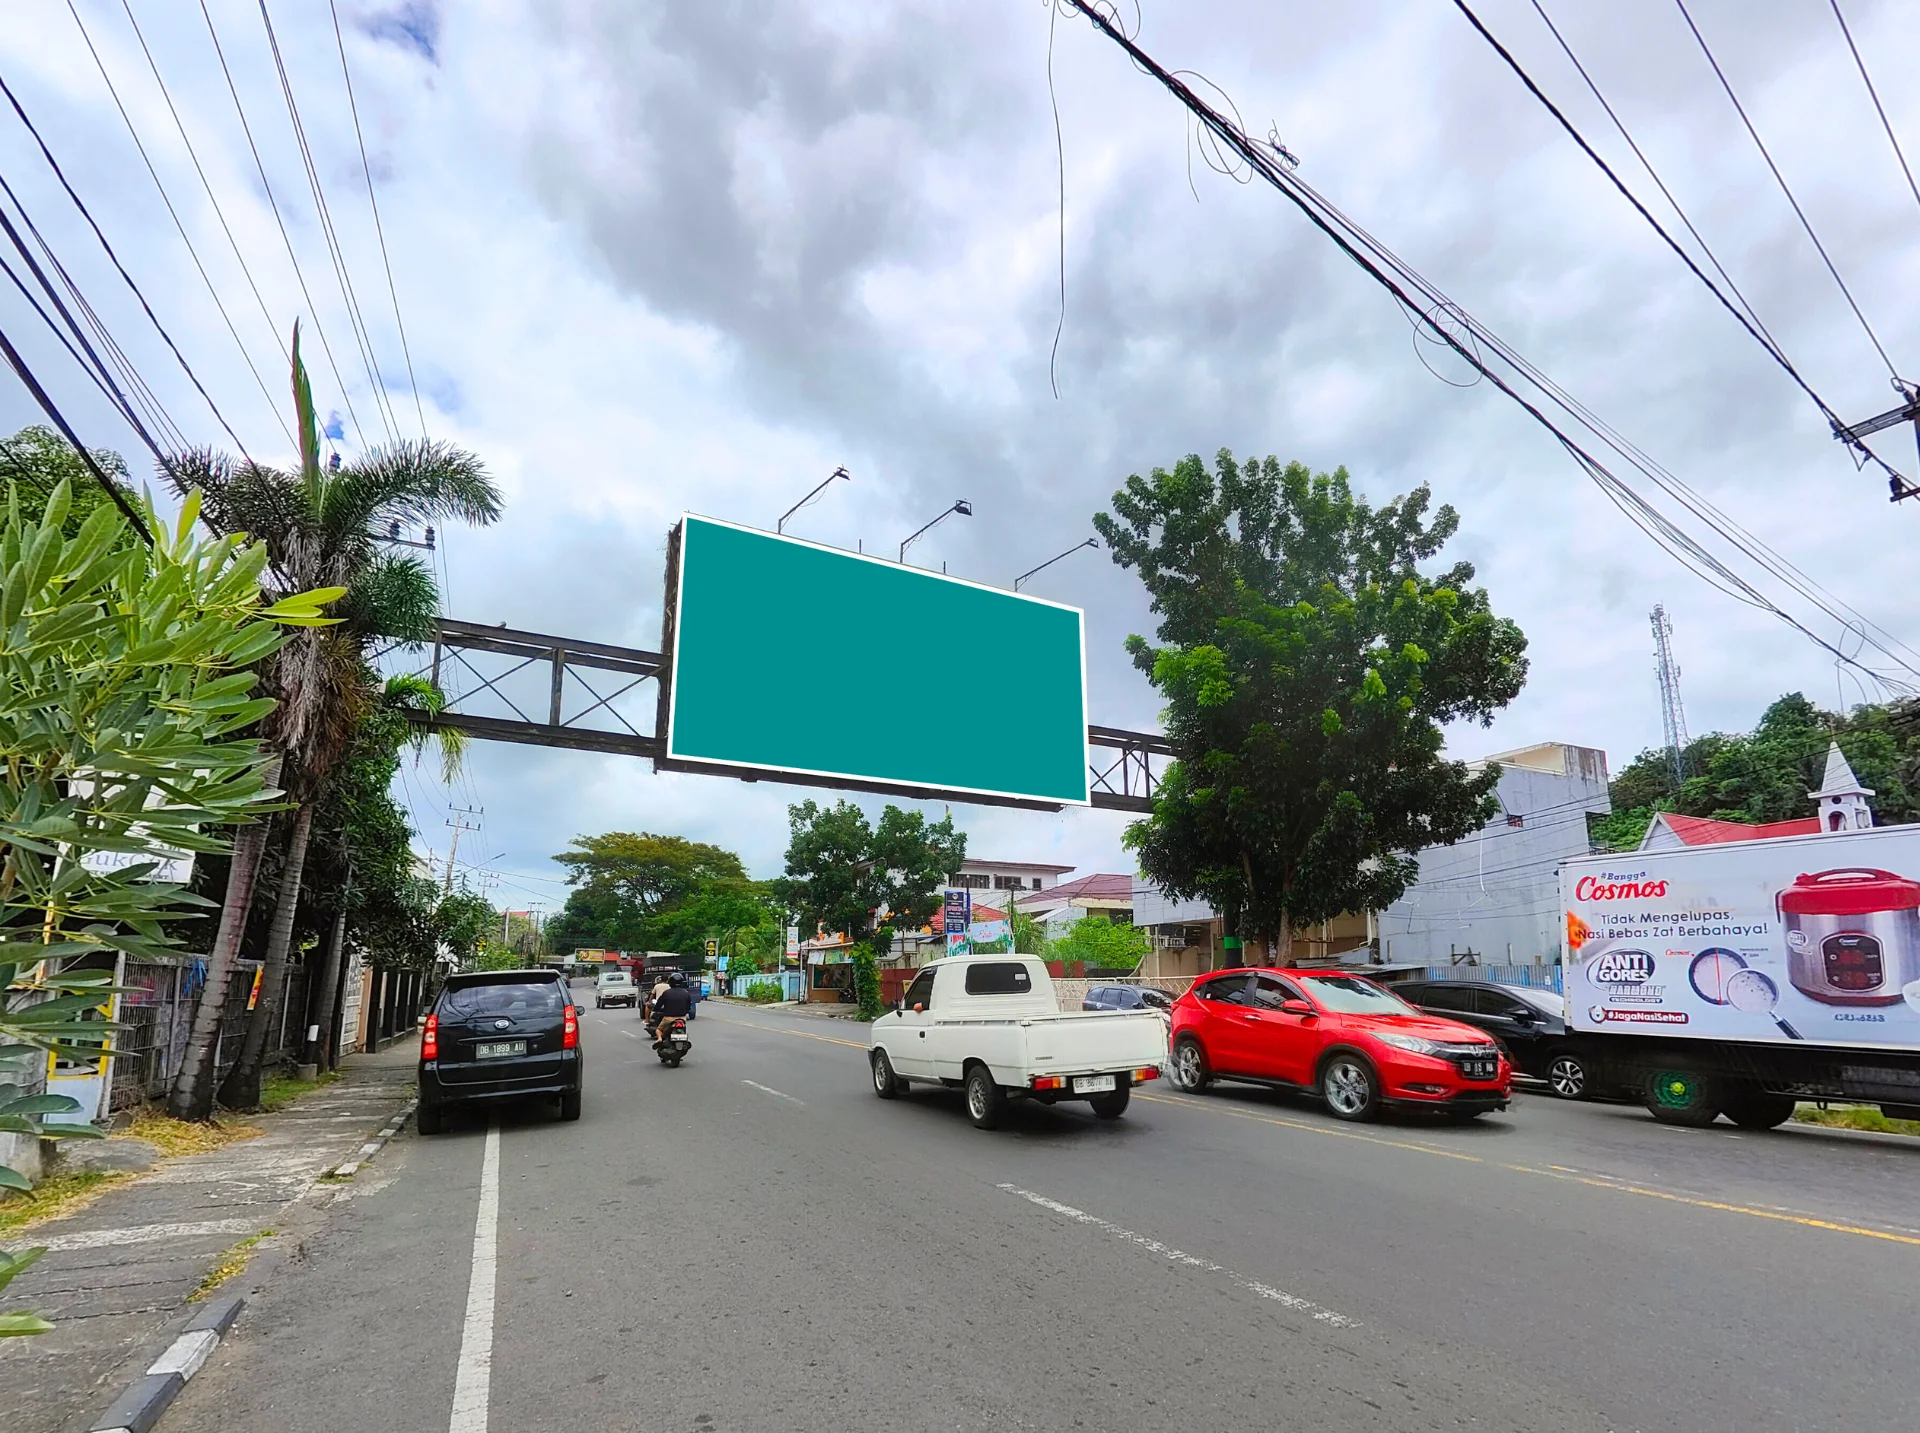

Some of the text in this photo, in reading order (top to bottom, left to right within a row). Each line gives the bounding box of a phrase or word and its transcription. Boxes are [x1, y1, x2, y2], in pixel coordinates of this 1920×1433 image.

[1600, 871, 1647, 882] #Bangga
[1575, 876, 1669, 901] Cosmos
[1601, 910, 1735, 925] Tidak Mengelupas,
[1577, 922, 1769, 939] Nasi Bebas Zat Berbahaya!
[1601, 954, 1649, 970] ANTI
[1598, 969, 1650, 982] GORES
[1607, 1012, 1686, 1022] #JagaNasiSehat
[480, 1045, 490, 1055] DB
[514, 1042, 524, 1051] AU
